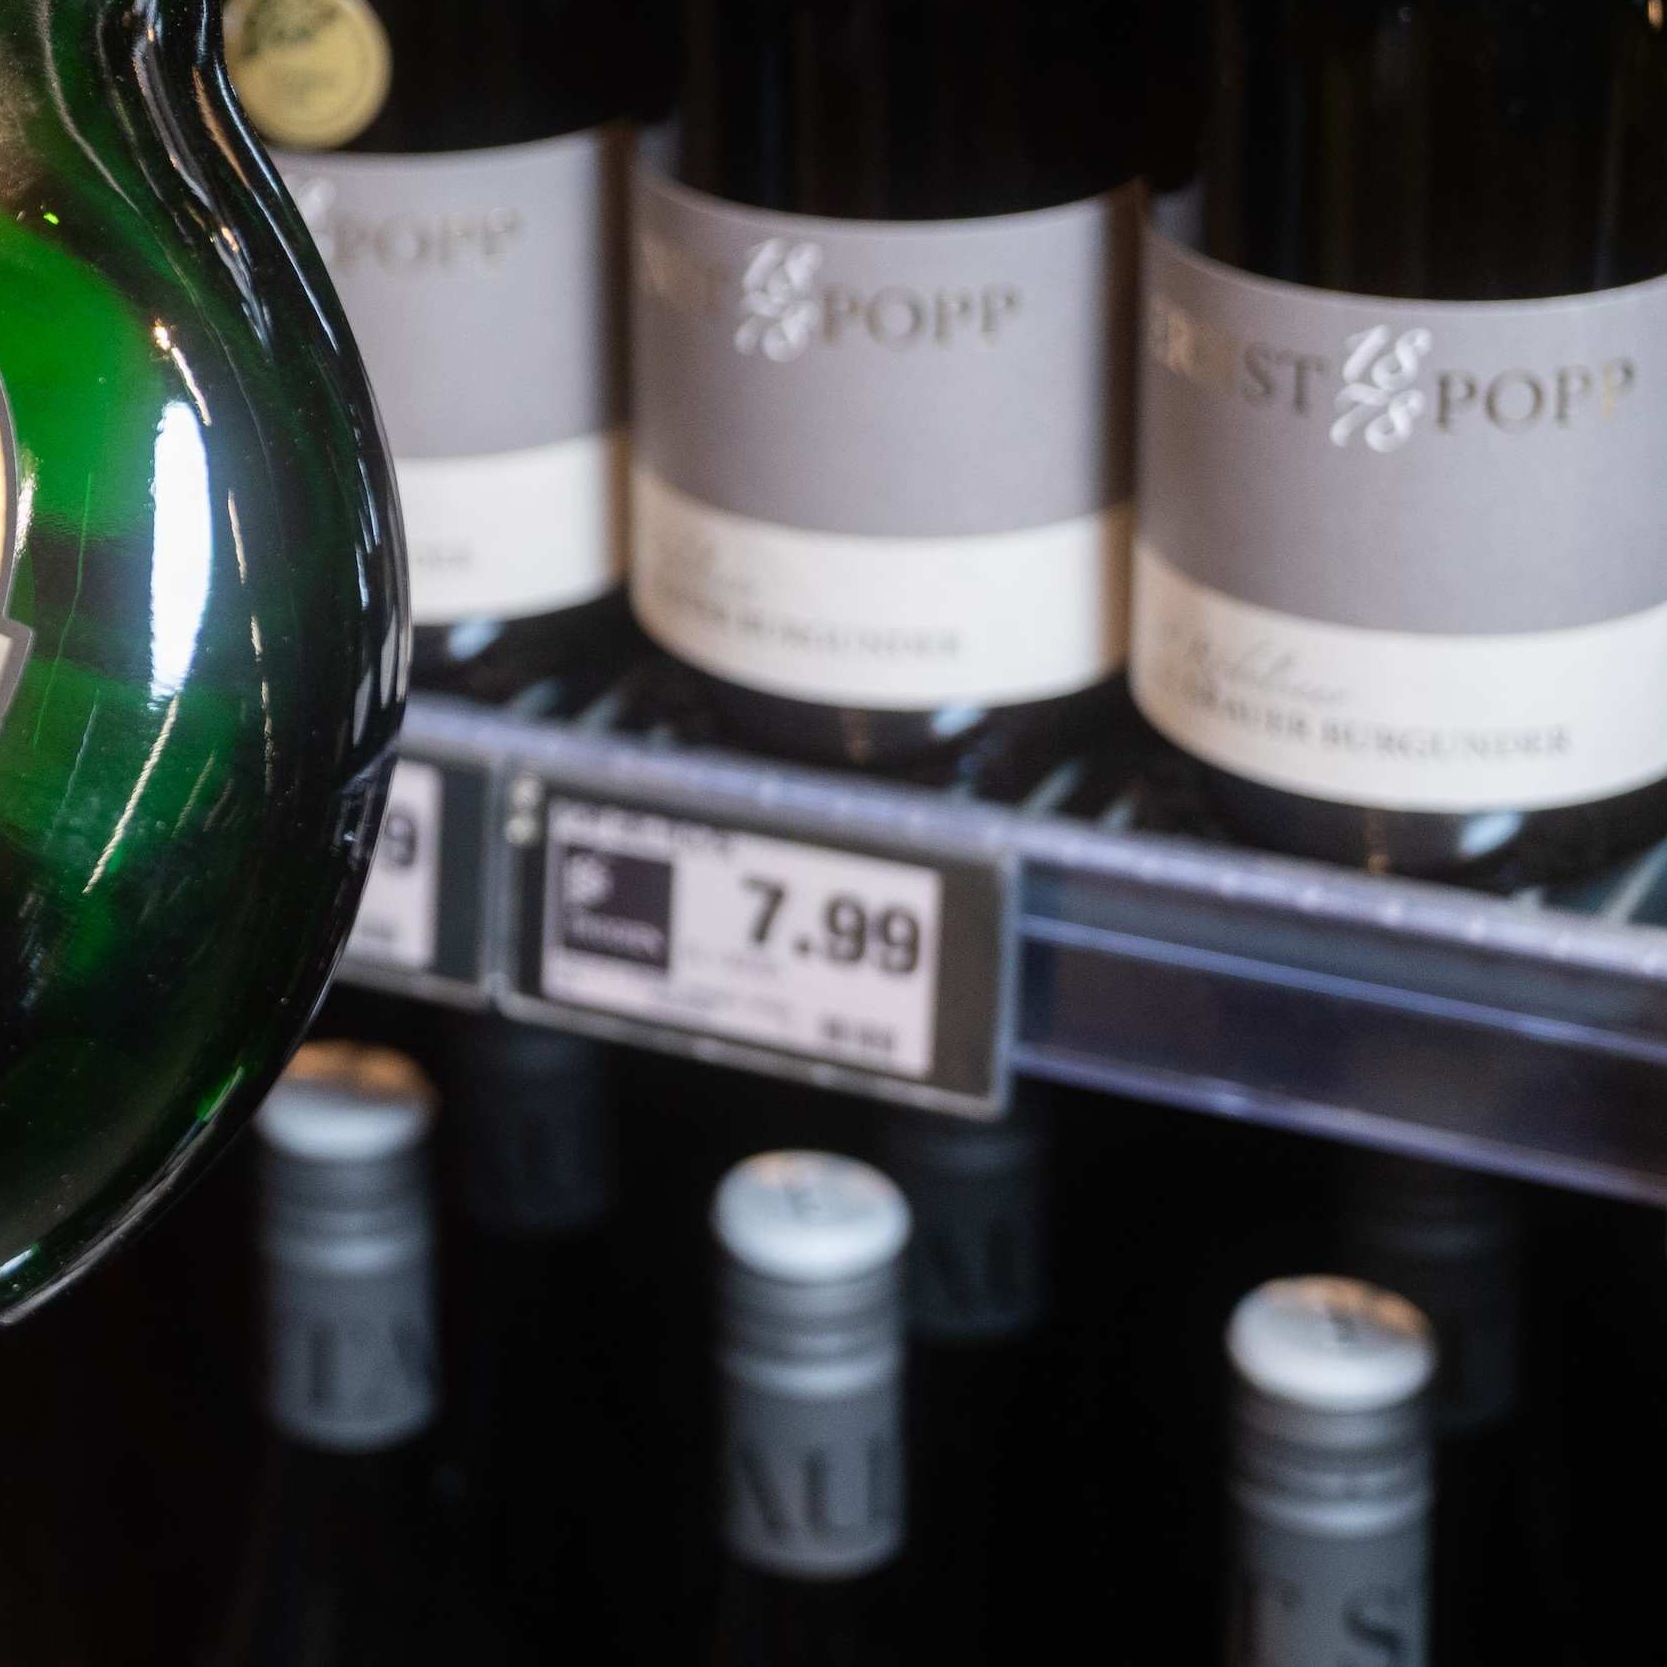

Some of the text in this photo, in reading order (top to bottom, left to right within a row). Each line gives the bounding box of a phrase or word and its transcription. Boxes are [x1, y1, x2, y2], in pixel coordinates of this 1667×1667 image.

[821, 282, 1020, 352] POPP
[1435, 356, 1636, 432] POPP
[738, 874, 925, 977] 7.99
